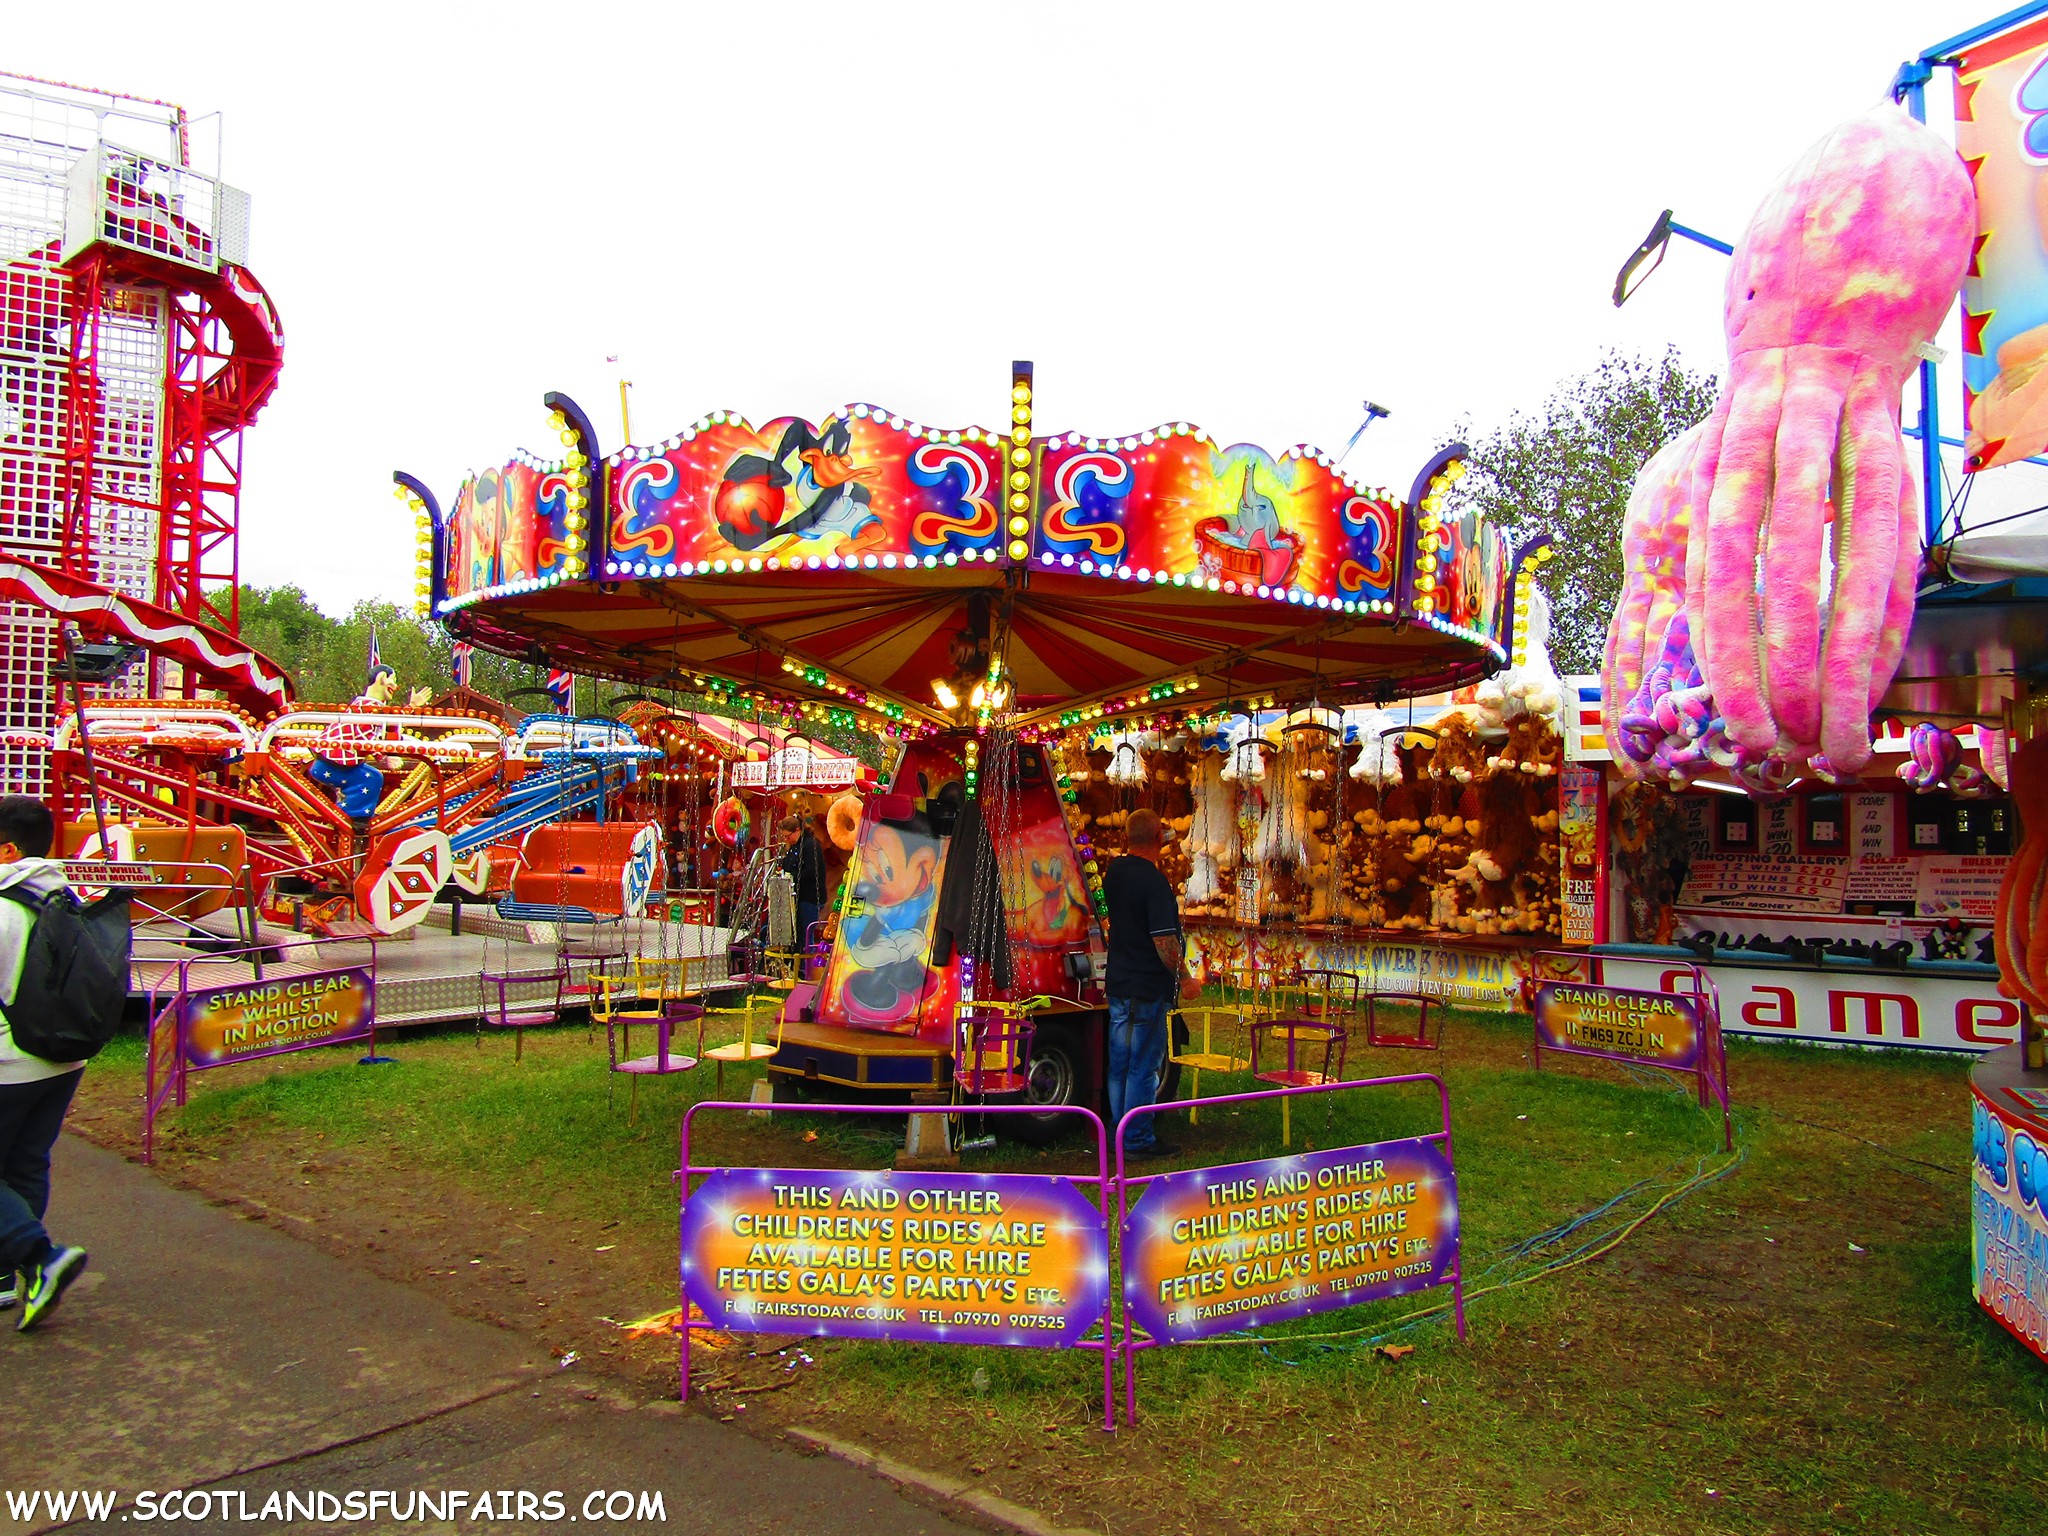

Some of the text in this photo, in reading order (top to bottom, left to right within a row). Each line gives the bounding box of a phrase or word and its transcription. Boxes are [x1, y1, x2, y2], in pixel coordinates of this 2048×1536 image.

[1563, 789, 1581, 820] 3
[1857, 796, 1886, 806] SCORE
[1866, 810, 1878, 820] 12
[1861, 824, 1882, 834] AND
[1862, 838, 1882, 848] WIN
[76, 865, 107, 874] CLEAR
[110, 866, 144, 875] WHILE
[1695, 852, 1848, 866] SHOOTING GALLERY
[1751, 864, 1792, 872] WINS
[1799, 866, 1836, 876] £20
[1961, 857, 1992, 866] RULES
[82, 873, 93, 881] IS
[95, 873, 106, 881] IN
[109, 874, 152, 882] MOTION
[1747, 873, 1789, 882] WINS
[1796, 876, 1833, 887] £10
[1746, 884, 1788, 893] WINS
[1795, 885, 1819, 895] £5
[1747, 901, 1795, 909] MONEY
[1565, 929, 1582, 939] YOU
[1566, 919, 1591, 929] EVEN
[1370, 946, 1418, 973] OVER
[1420, 948, 1432, 975] 3
[1434, 951, 1459, 978] TO
[1463, 953, 1506, 984] WIN
[209, 974, 352, 1013] STAND CLEAR
[1415, 980, 1442, 996] EVEN
[1442, 982, 1453, 998] IF
[1455, 984, 1474, 999] YOU
[1475, 986, 1501, 1002] LOSE
[1554, 987, 1676, 1015] STAND CLEAR
[242, 996, 323, 1025] WHILST
[1579, 1007, 1648, 1029] WHILST
[223, 1009, 339, 1047] IN MOTION
[1582, 1025, 1614, 1044] FM69
[1616, 1030, 1643, 1047] ZCJ
[231, 1029, 333, 1055] FUNFAIRSTODAY.CO.UK
[1207, 1159, 1387, 1207] THIS AND OTHER
[773, 1185, 1004, 1214] THIS AND OTHER
[1171, 1181, 1417, 1244] CHILDREN'S RIDES ARE
[733, 1213, 1047, 1246] CHILDREN'S RIDES ARE
[1186, 1209, 1408, 1271] AVAILABLE FOR HIRE
[747, 1242, 1031, 1275] AVAILABLE FOR HIRE
[1159, 1236, 1433, 1304] FETES GALA'S PARTY'S ETC.
[1329, 1269, 1390, 1292] TEL.07970
[1394, 1260, 1433, 1278] 907525
[717, 1267, 1067, 1304] FETES GALA'S PARTY'S ETC.
[919, 1309, 1001, 1327] TEL.07970
[1009, 1314, 1066, 1330] 907525
